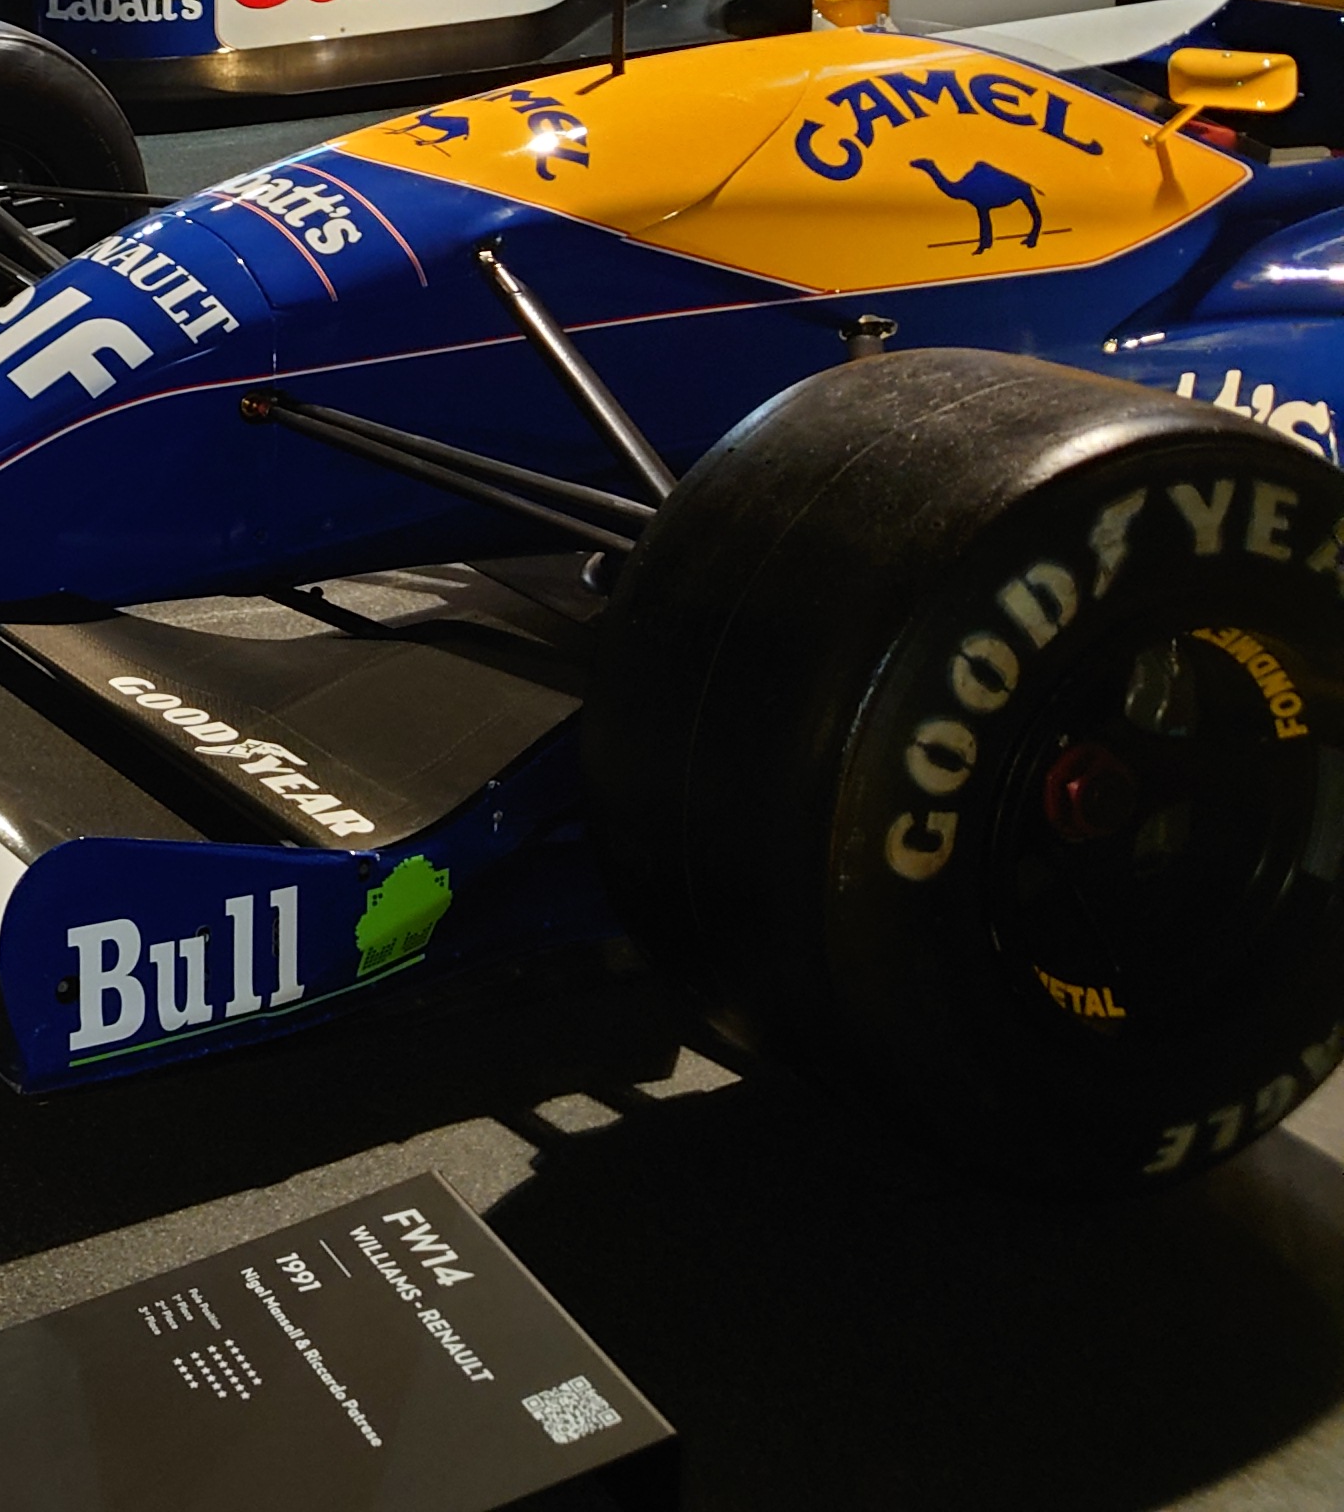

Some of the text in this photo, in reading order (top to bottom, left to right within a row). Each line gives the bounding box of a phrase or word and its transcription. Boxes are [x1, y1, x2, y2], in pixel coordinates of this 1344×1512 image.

[492, 88, 590, 182] MEL
[795, 67, 1104, 182] CAMEL
[80, 235, 241, 345] NAULT
[108, 675, 375, 838] GOODYEAR
[67, 885, 306, 1052] Bull
[274, 1251, 323, 1295] 1991
[349, 1223, 422, 1303] WILLIAMS
[416, 1306, 495, 1384] RENAULT
[381, 1207, 475, 1288] FW14
[198, 1301, 223, 1331] Position
[240, 1266, 271, 1306] Nigel
[262, 1295, 306, 1341] Mansell
[302, 1347, 348, 1401] Riccardo
[342, 1398, 384, 1448] Patrese
